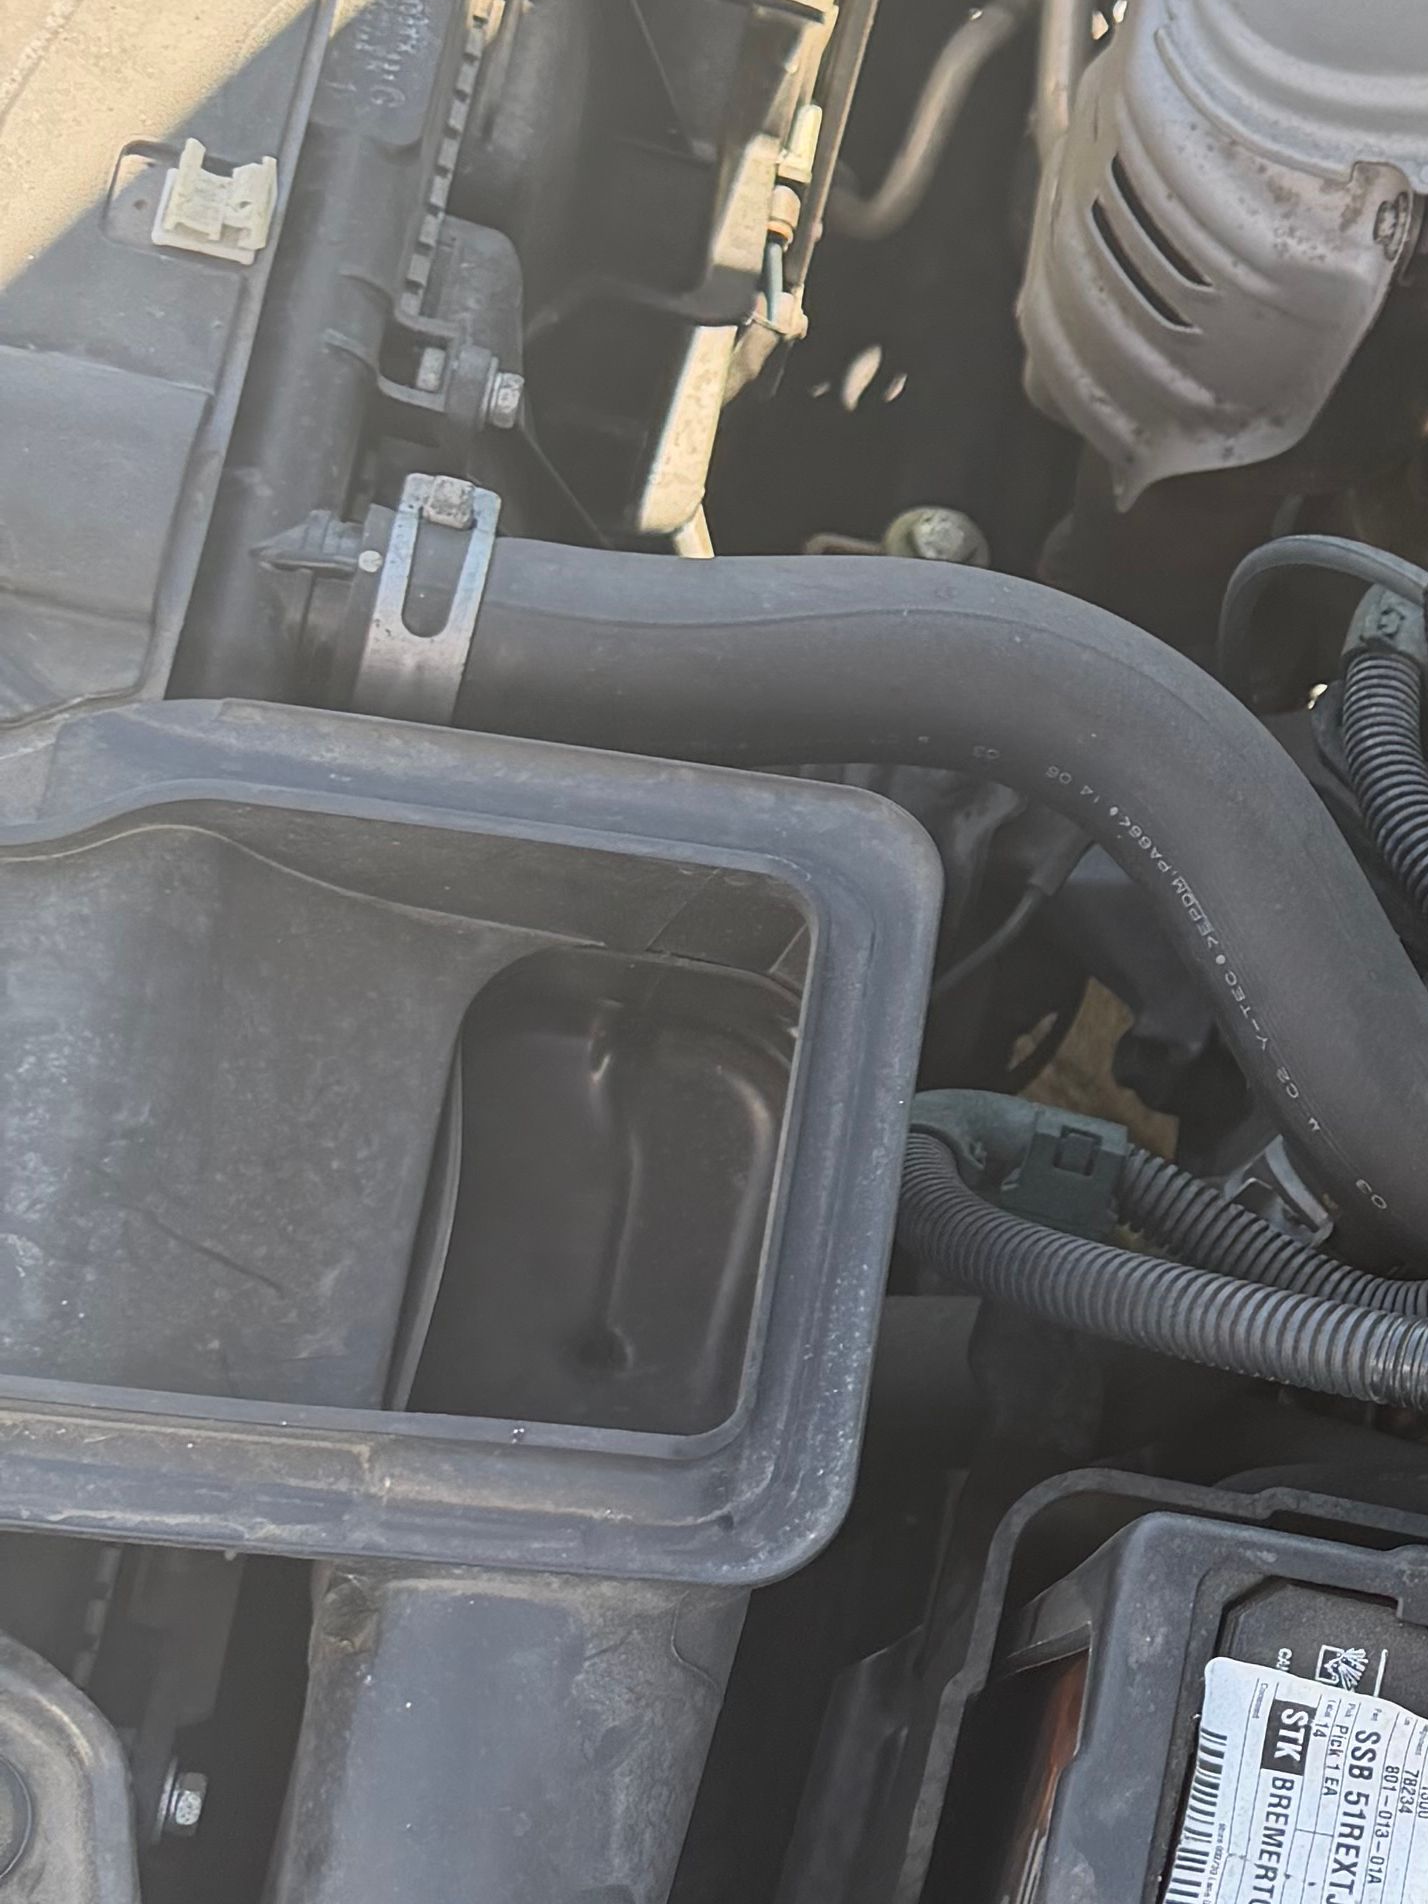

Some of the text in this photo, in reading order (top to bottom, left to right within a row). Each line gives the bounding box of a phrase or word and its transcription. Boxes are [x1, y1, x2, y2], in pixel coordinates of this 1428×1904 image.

[1274, 1708, 1308, 1761] STK
[1312, 1722, 1329, 1738] 14
[1327, 1723, 1349, 1757] Pick
[1348, 1730, 1381, 1780] SSB
[1322, 1776, 1339, 1796] EA
[1398, 1769, 1420, 1813] 78234
